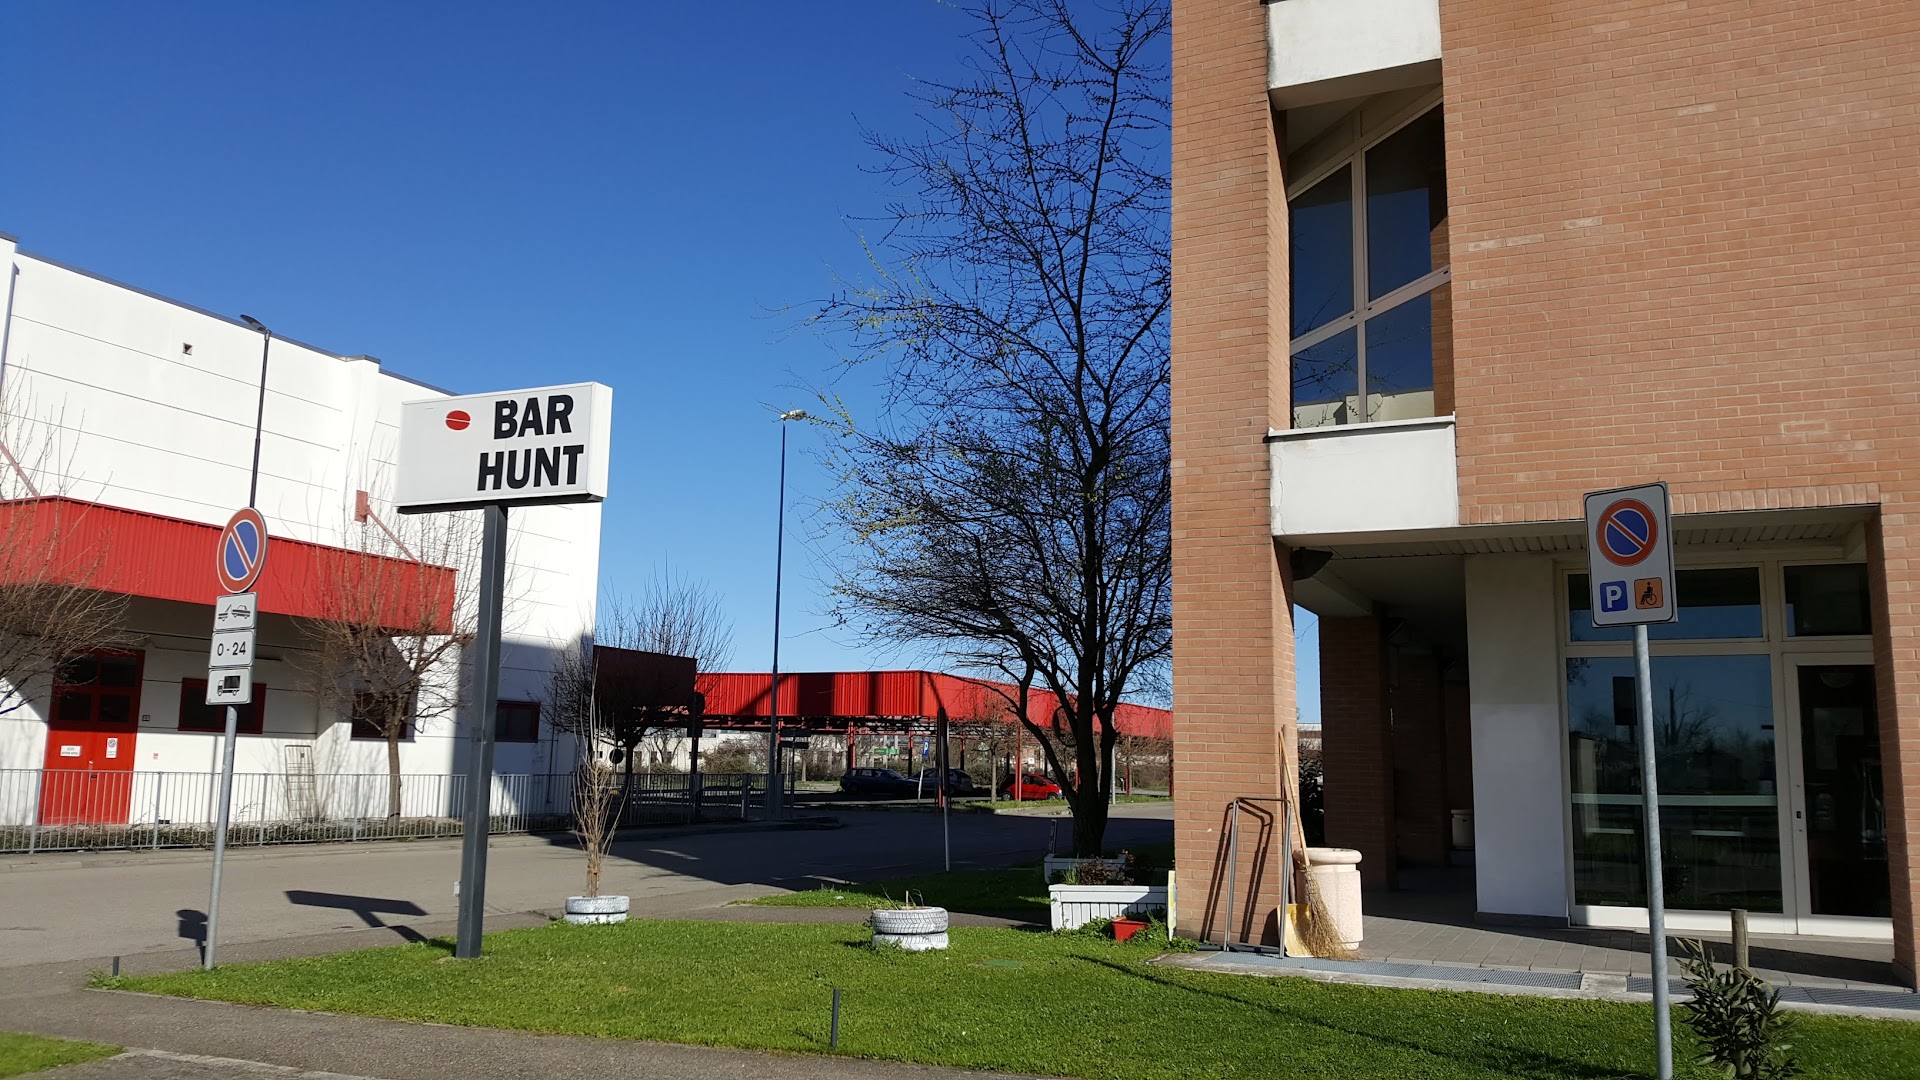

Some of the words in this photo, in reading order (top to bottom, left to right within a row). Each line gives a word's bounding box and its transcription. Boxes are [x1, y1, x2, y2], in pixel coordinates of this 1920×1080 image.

[493, 394, 574, 440] BAR
[477, 444, 585, 491] HUNT
[1606, 585, 1622, 609] P
